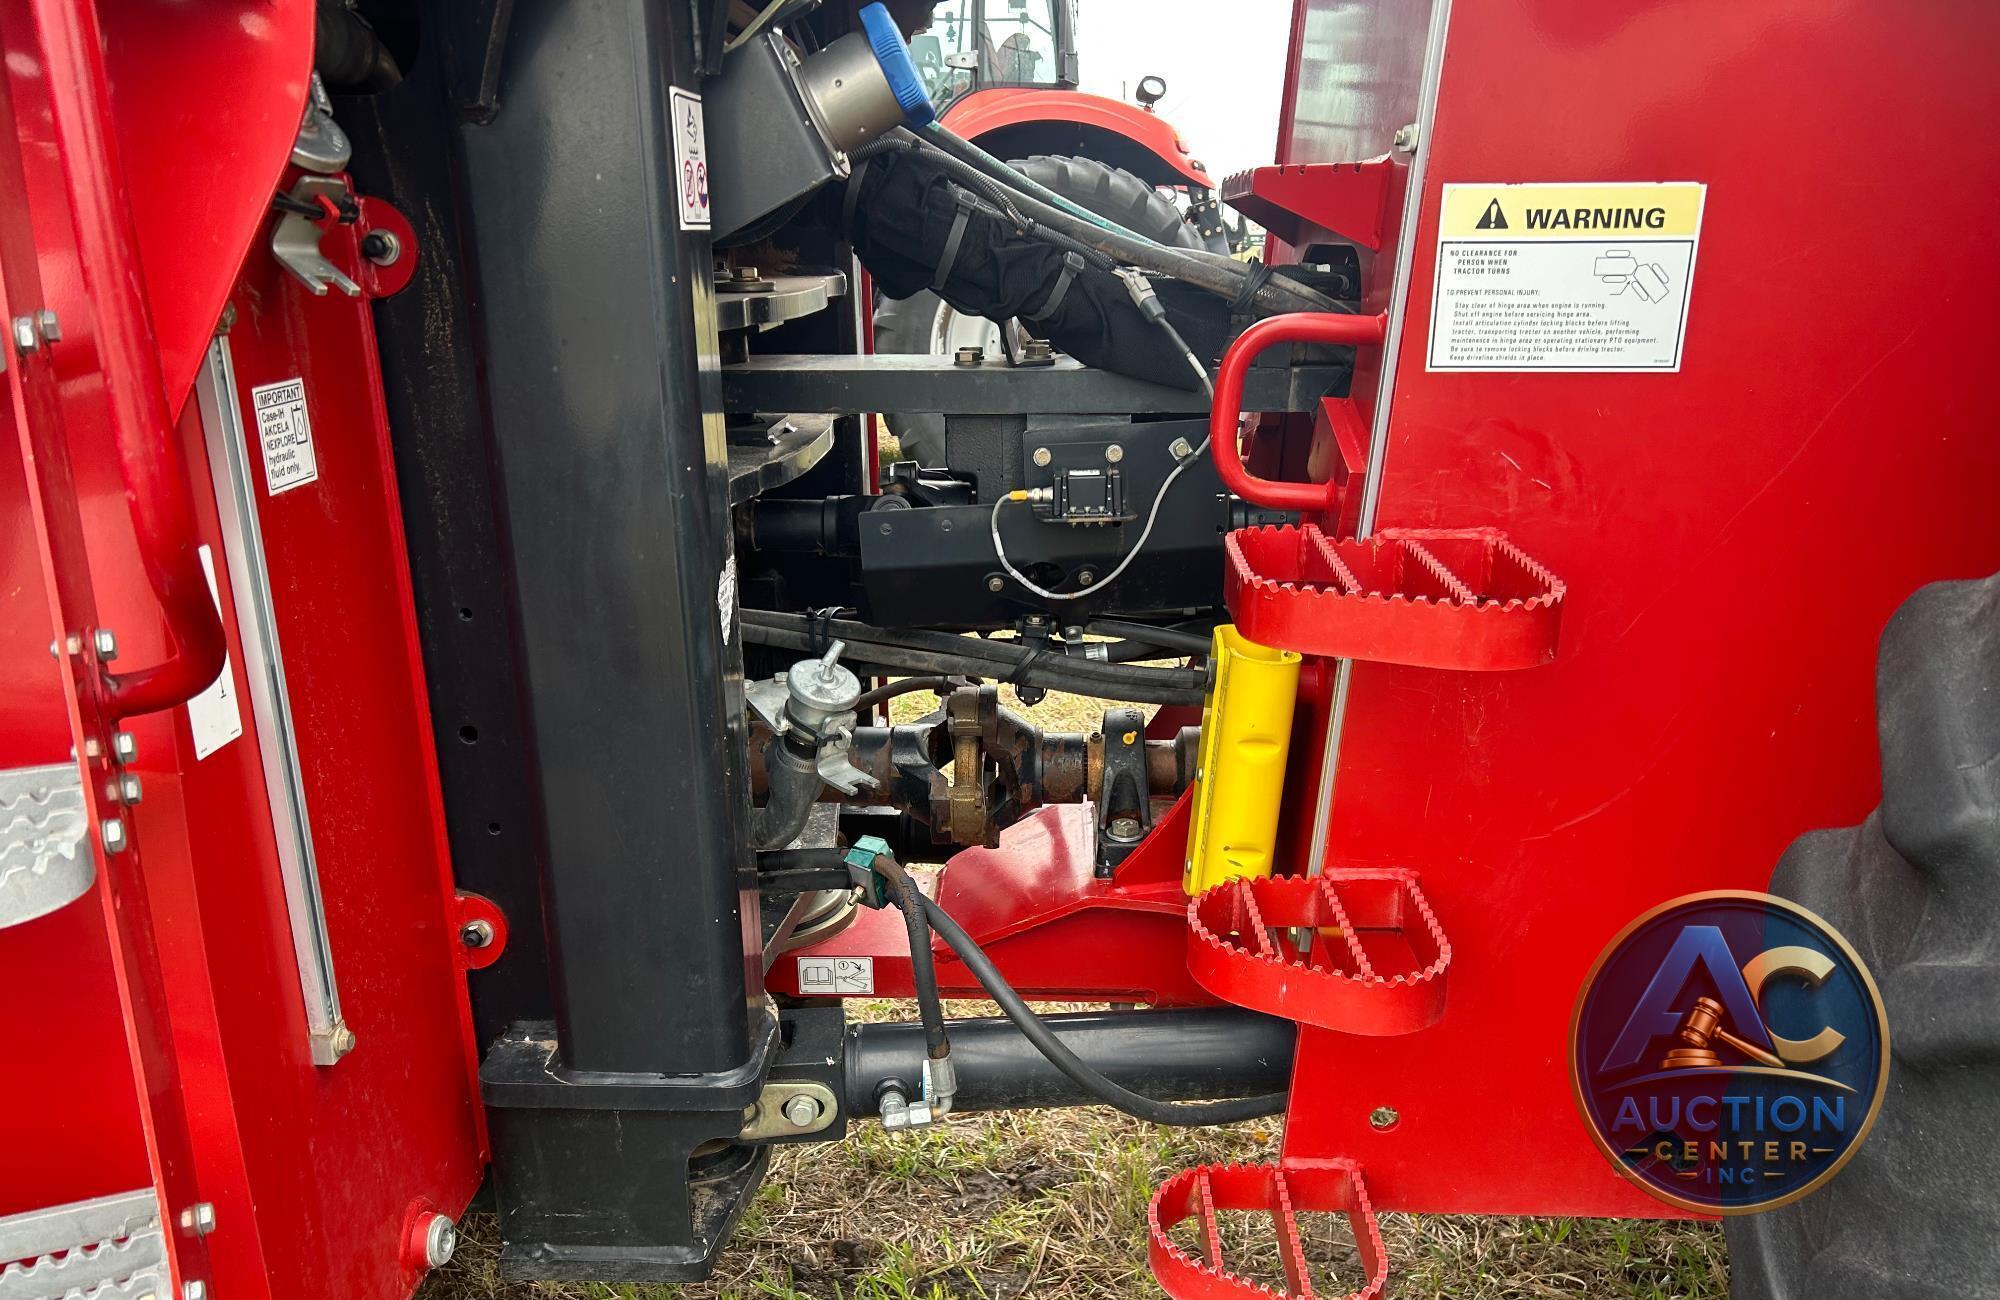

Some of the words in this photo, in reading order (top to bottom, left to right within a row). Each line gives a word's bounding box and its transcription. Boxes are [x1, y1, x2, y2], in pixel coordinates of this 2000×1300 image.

[1525, 208, 1666, 229] WARNING
[1513, 320, 1539, 328] cylinder
[258, 386, 301, 407] IMPORTANT
[264, 421, 289, 437] AKCELA
[266, 433, 296, 451] NEXPLORE
[268, 449, 296, 467] hydraulic
[270, 465, 286, 480] fluid
